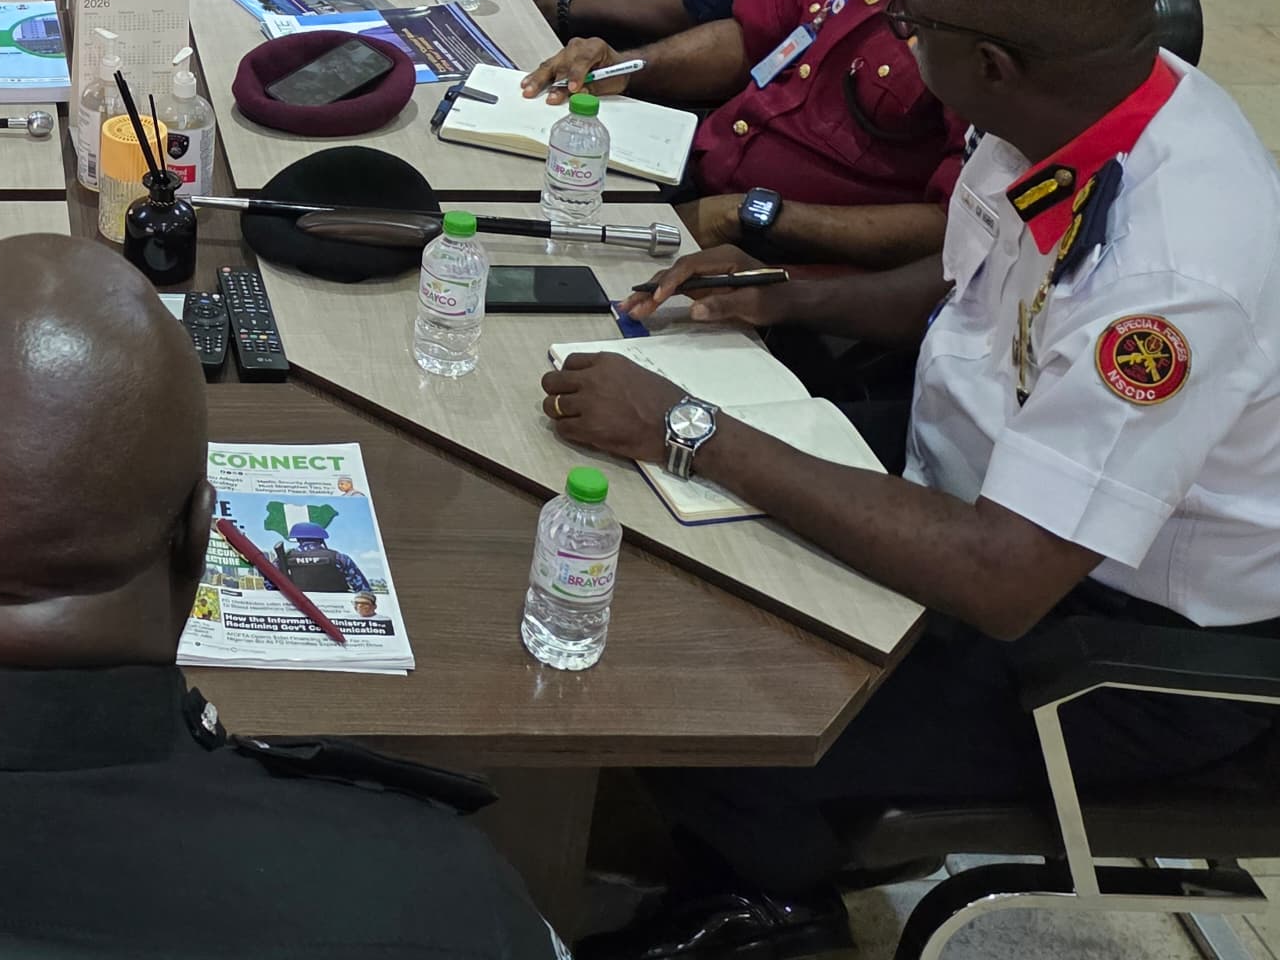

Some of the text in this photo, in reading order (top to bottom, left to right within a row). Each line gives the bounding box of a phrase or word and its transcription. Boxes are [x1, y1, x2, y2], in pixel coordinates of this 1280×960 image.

[1115, 318, 1161, 335] SPECIAL
[1107, 369, 1156, 400] NSCDC
[209, 452, 345, 471] CONNECT
[296, 556, 320, 564] NPF
[567, 572, 613, 587] BRAYCO
[225, 614, 247, 622] How
[249, 615, 265, 623] the
[226, 620, 279, 631] Redefining
[281, 623, 306, 632] Gov't
